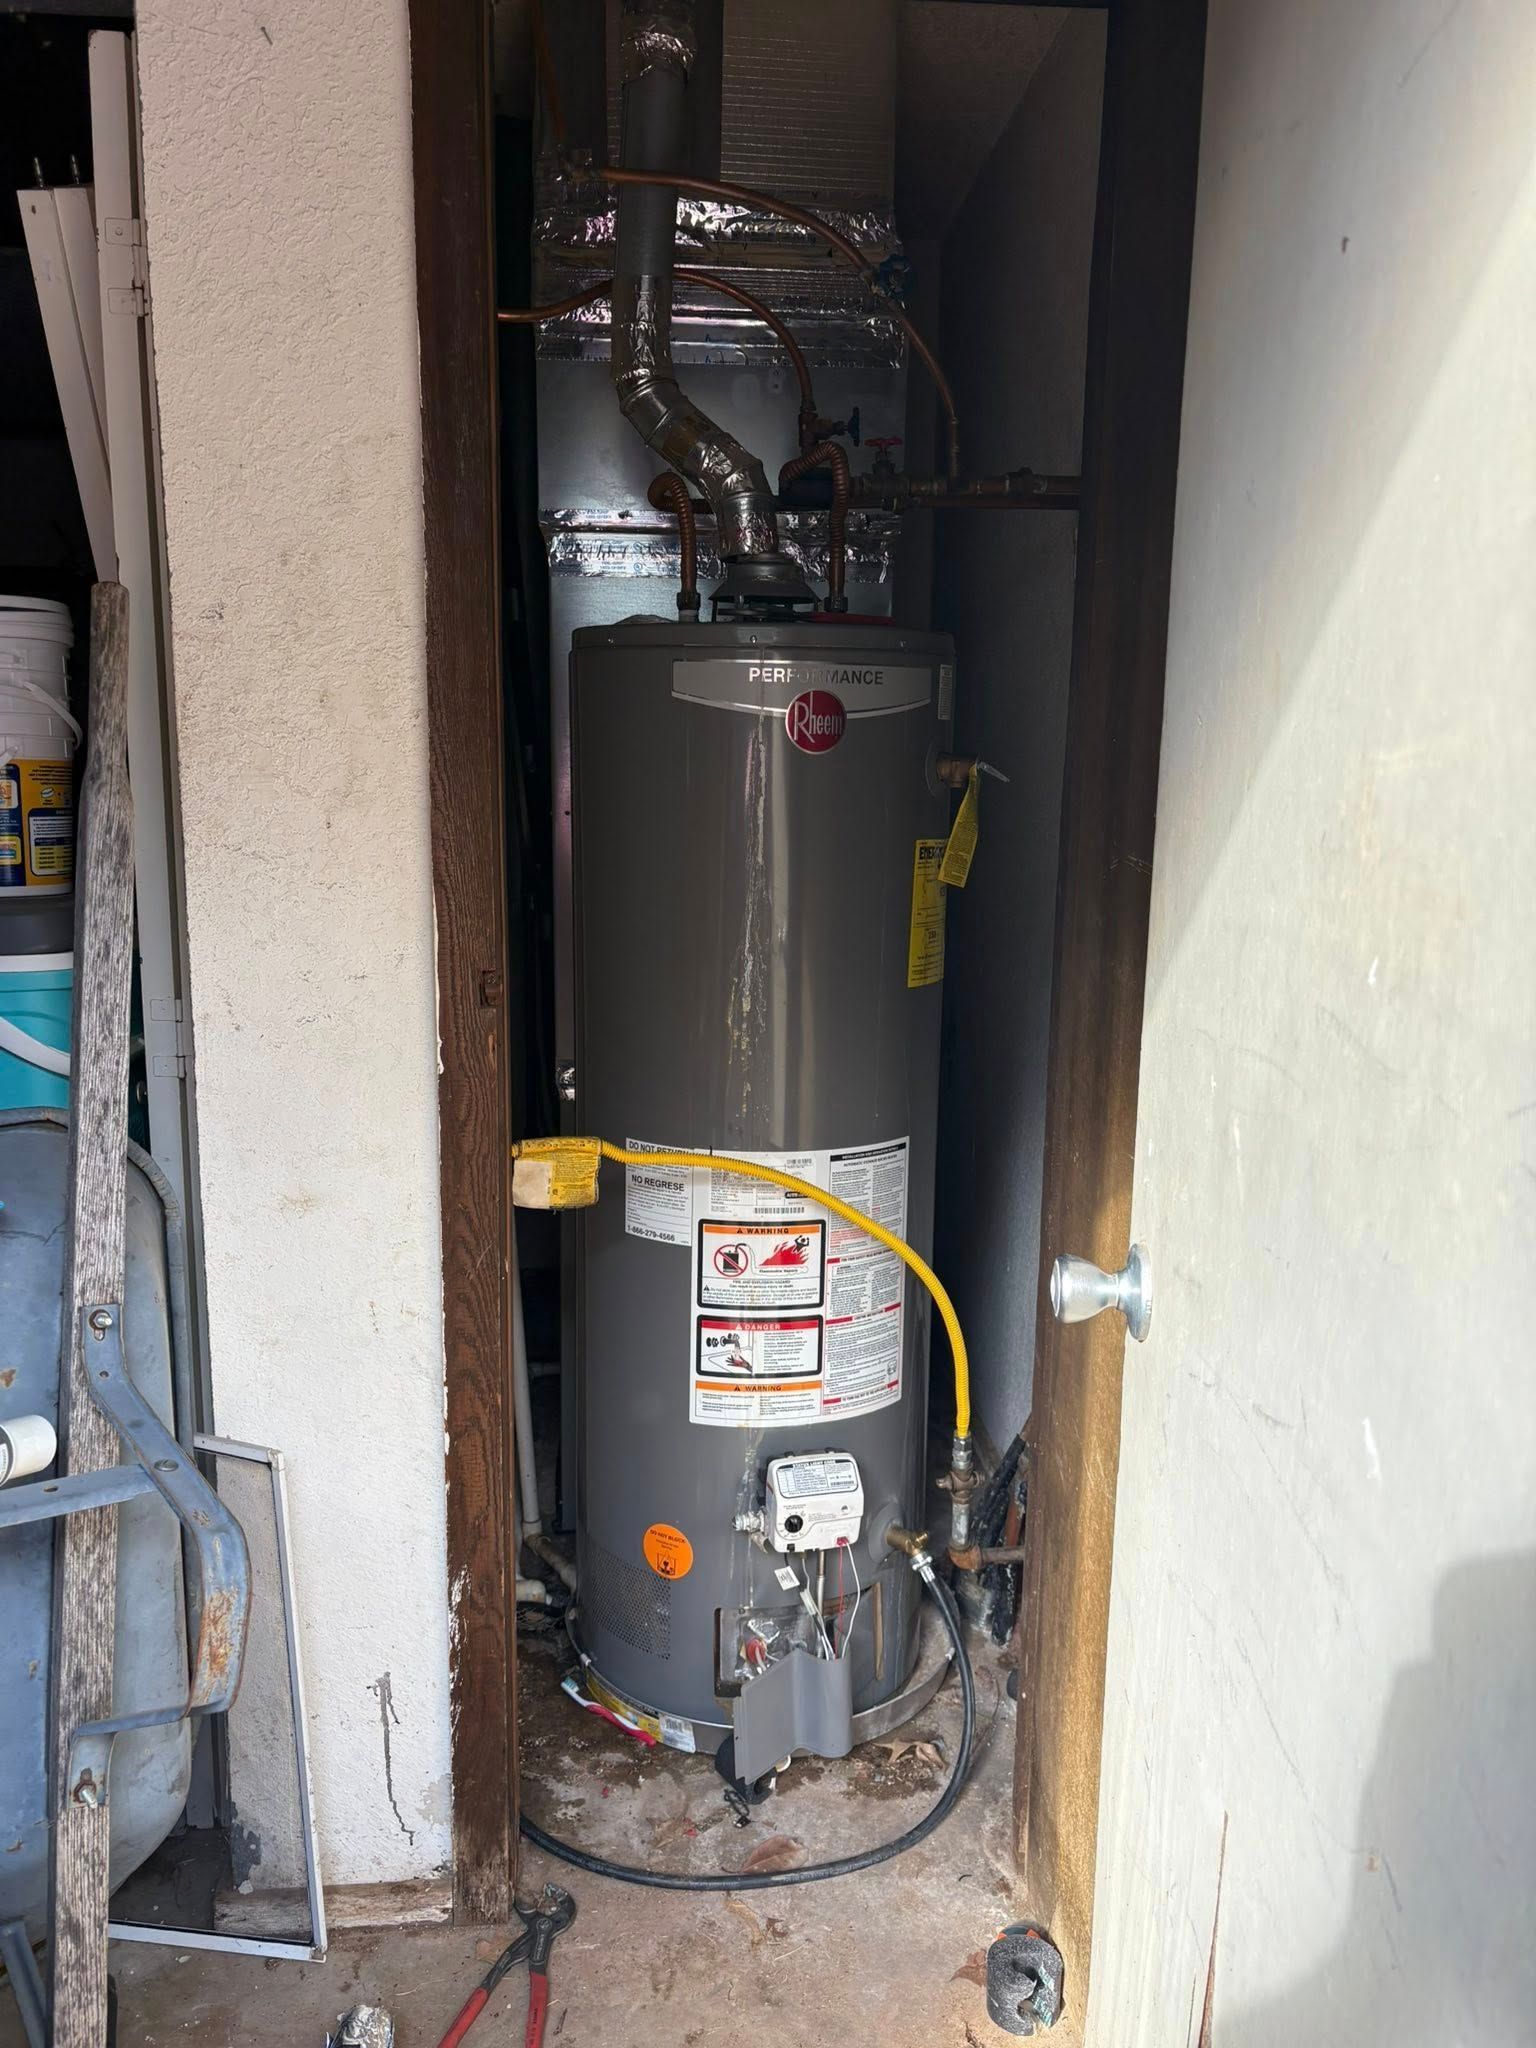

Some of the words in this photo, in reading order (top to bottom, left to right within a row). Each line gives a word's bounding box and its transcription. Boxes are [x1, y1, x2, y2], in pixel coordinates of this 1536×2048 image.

[749, 667, 883, 685] PERFORMANCE
[793, 691, 843, 743] Rheem
[629, 1141, 639, 1150] DO
[640, 1143, 655, 1153] NOT
[631, 1175, 643, 1184] NO
[644, 1178, 685, 1192] REGRESE
